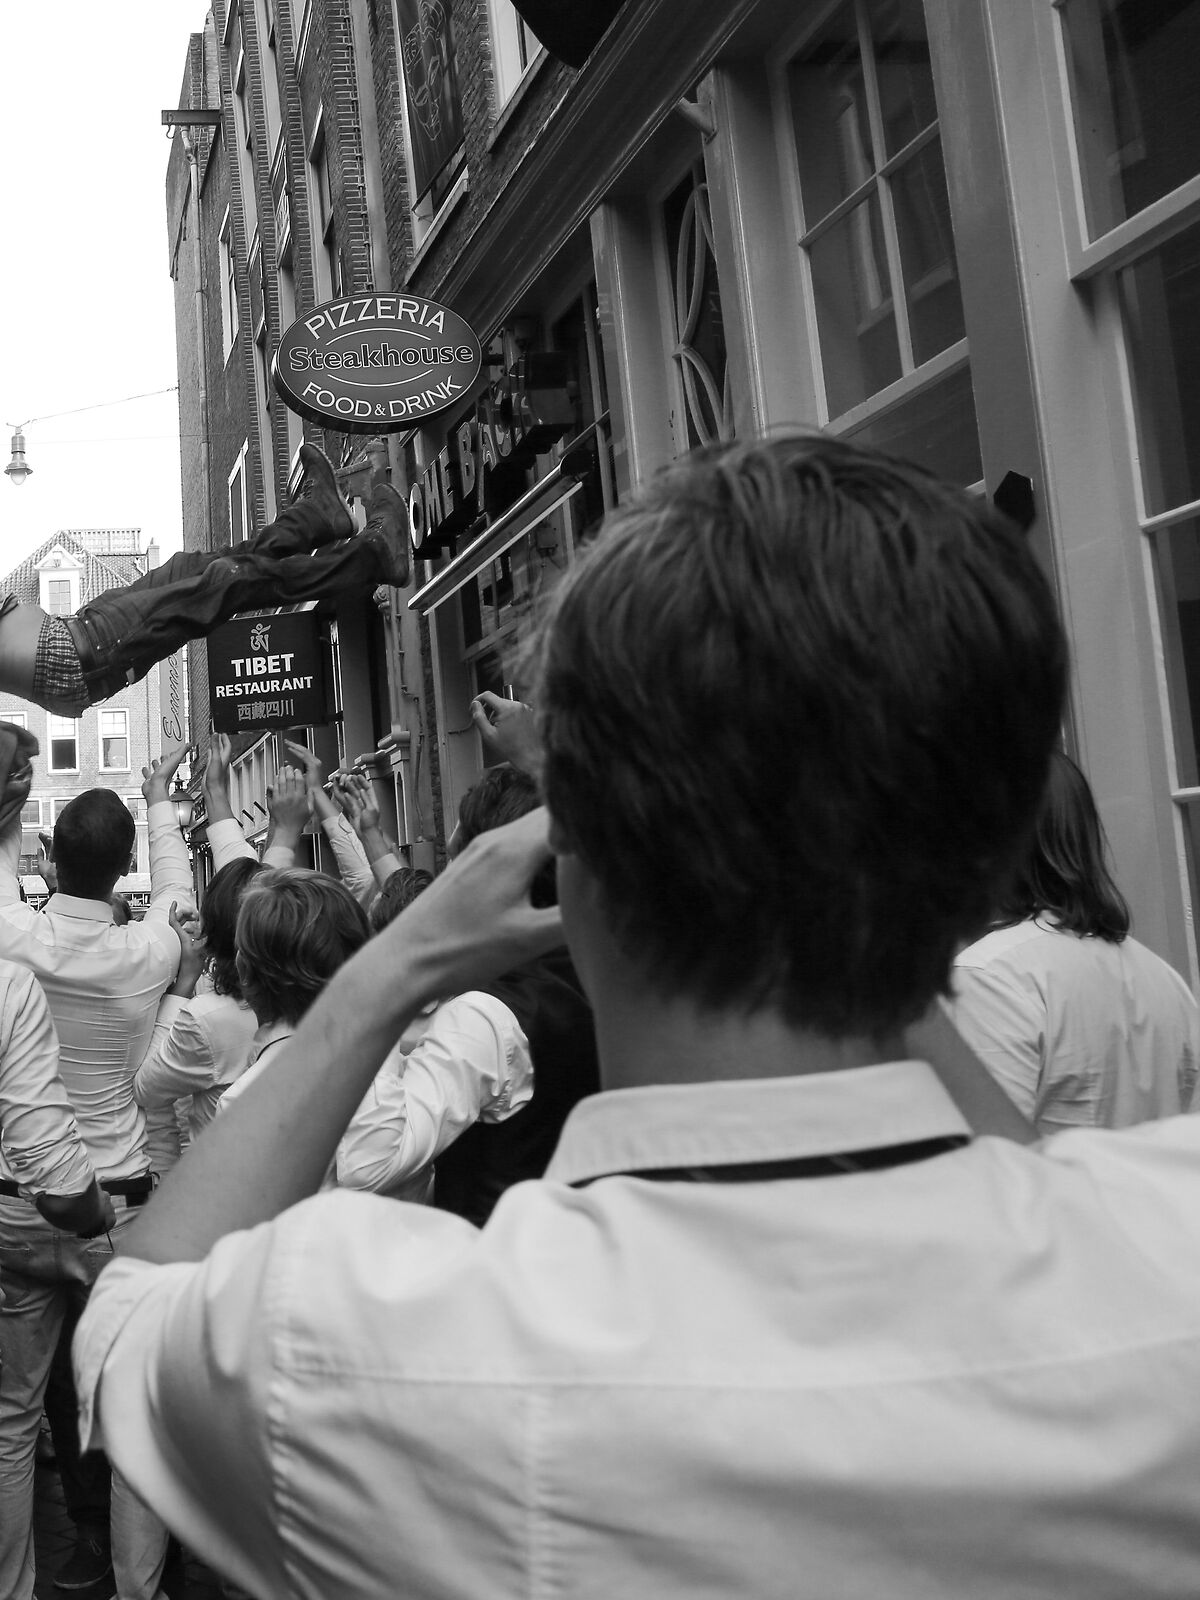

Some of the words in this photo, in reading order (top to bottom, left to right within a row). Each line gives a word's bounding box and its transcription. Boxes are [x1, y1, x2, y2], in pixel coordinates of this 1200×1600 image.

[304, 297, 445, 340] PIZZERIA
[289, 343, 474, 371] Steakhouse
[302, 382, 372, 417] FOOD
[374, 403, 386, 416] &
[390, 375, 463, 417] DRINK
[409, 446, 455, 550] OME
[231, 653, 295, 678] TIBET
[215, 676, 314, 698] RESTAURANT
[237, 698, 294, 721] 西藏四川
